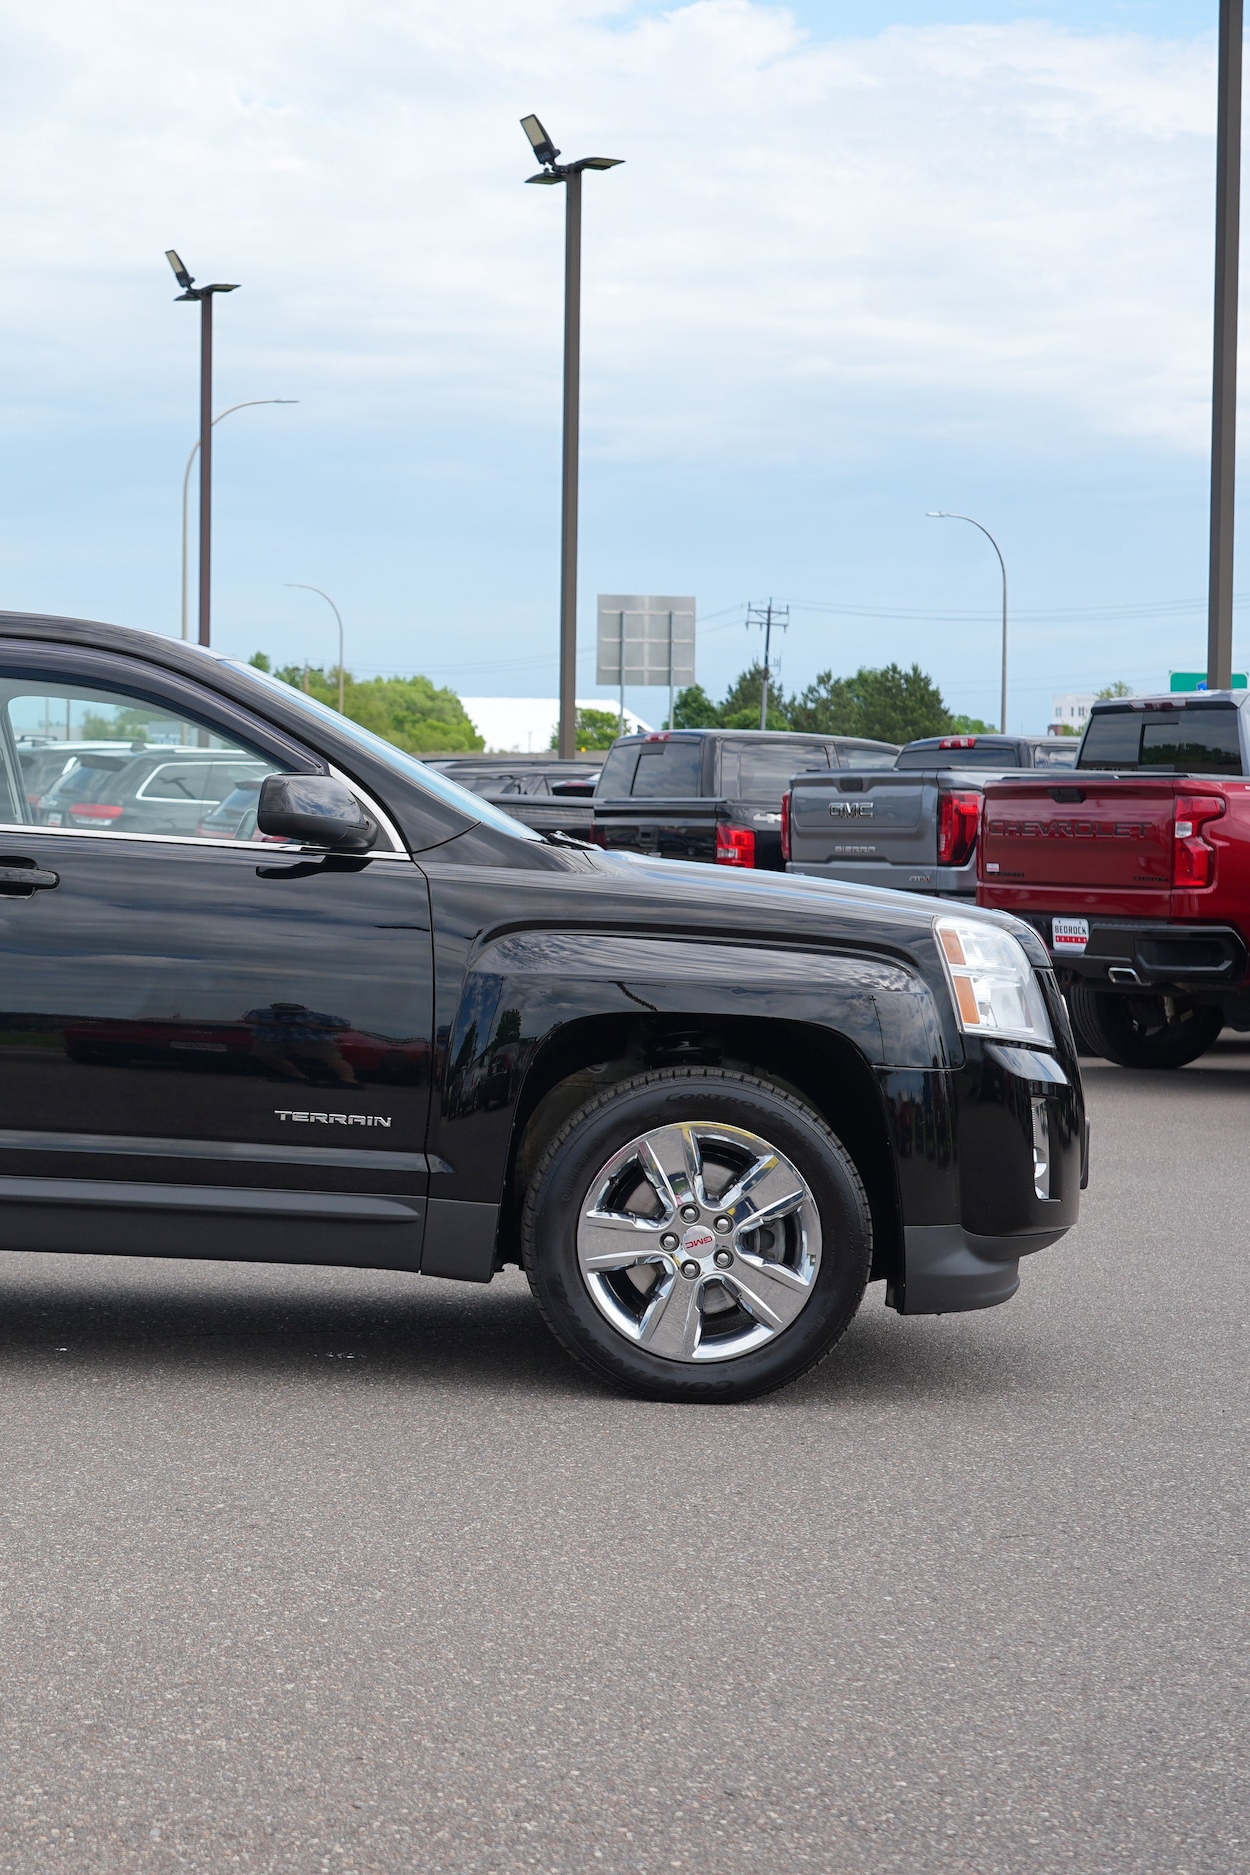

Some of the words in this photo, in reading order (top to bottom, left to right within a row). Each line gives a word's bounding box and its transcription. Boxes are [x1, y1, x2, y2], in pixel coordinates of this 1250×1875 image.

[828, 802, 874, 818] GMC
[989, 820, 1153, 838] CHEVROLET
[834, 845, 876, 853] SIERRA
[1055, 925, 1087, 935] BEDROCK
[274, 1110, 392, 1128] TERRAIN
[685, 1235, 713, 1249] GMC
